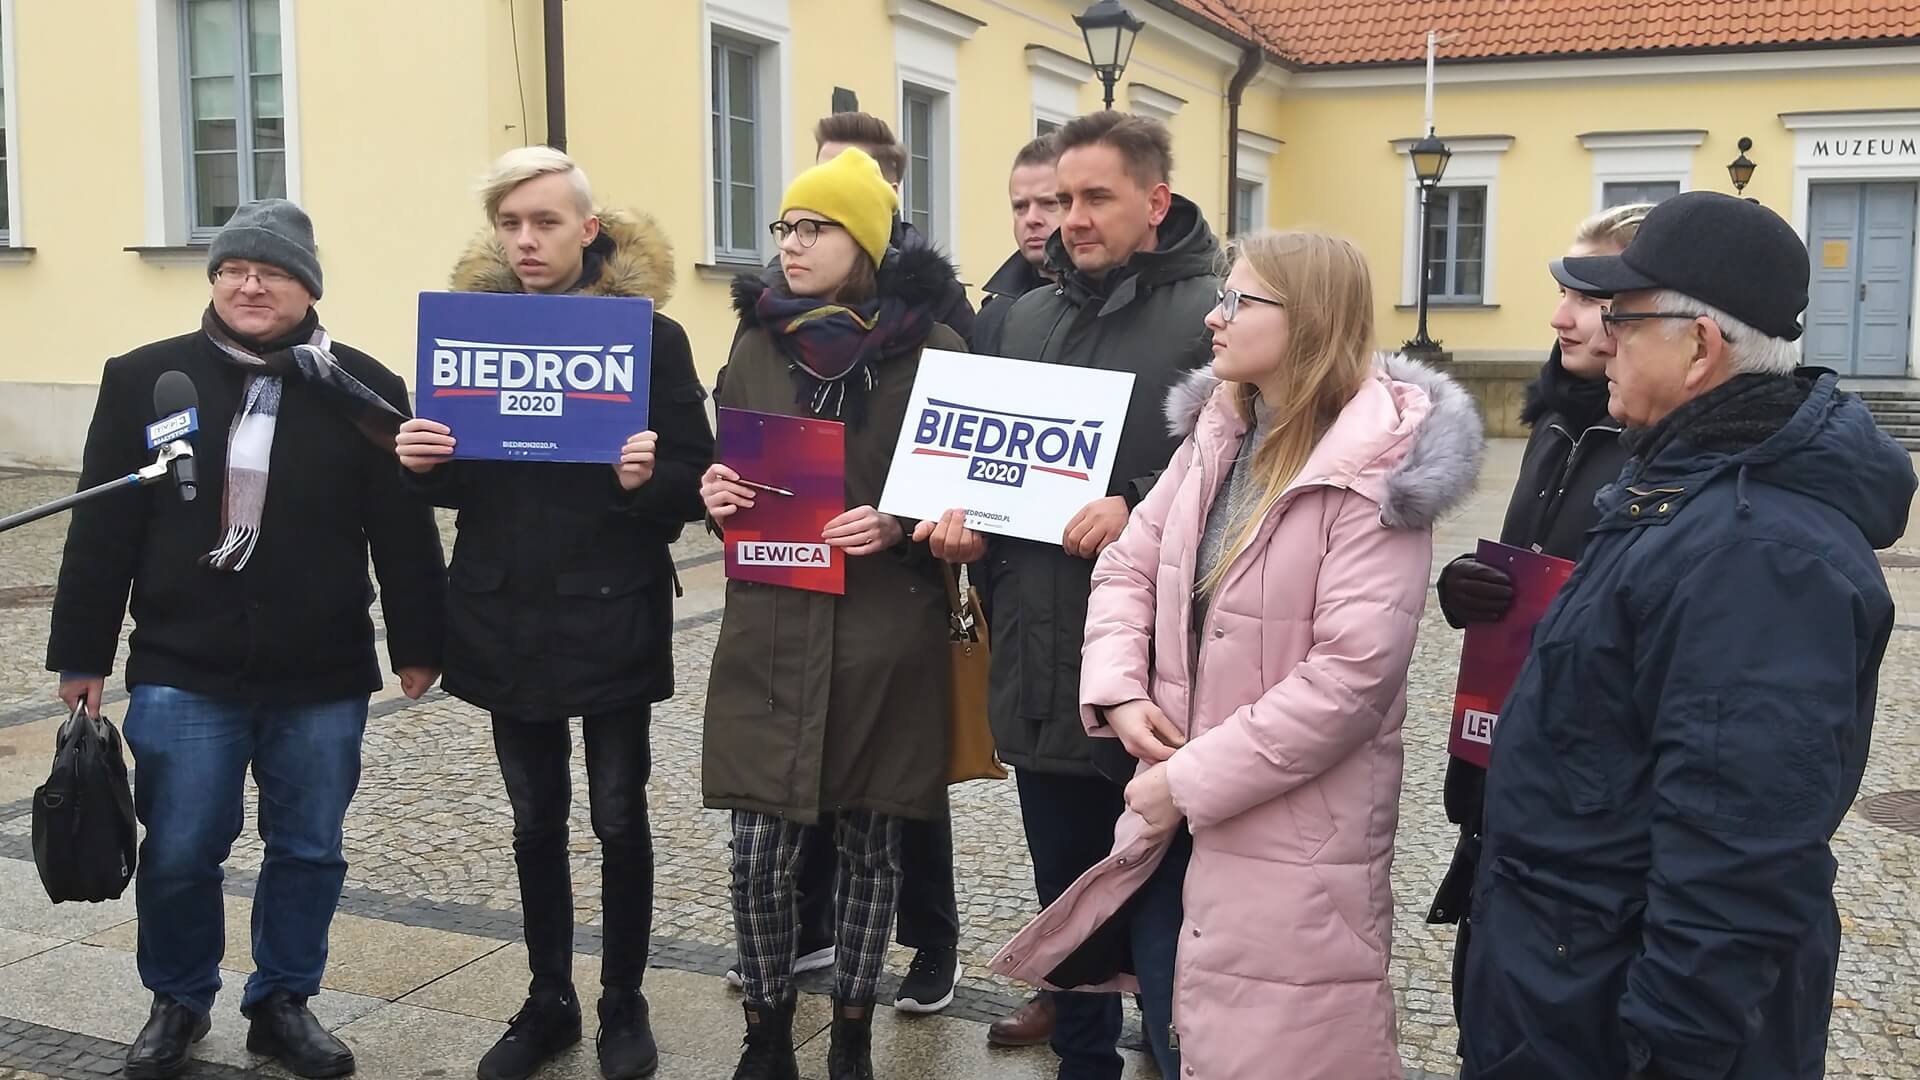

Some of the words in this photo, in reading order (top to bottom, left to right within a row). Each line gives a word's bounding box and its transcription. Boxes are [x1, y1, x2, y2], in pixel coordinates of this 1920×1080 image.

[1813, 138, 1917, 156] MUZEUM
[433, 344, 634, 392] BIEDROŃ
[507, 395, 556, 412] 2020
[914, 408, 1104, 470] BIEDROŃ
[973, 461, 1020, 483] 2020
[964, 508, 1011, 523] IEDRON2020.PL
[744, 545, 826, 563] LEWICA
